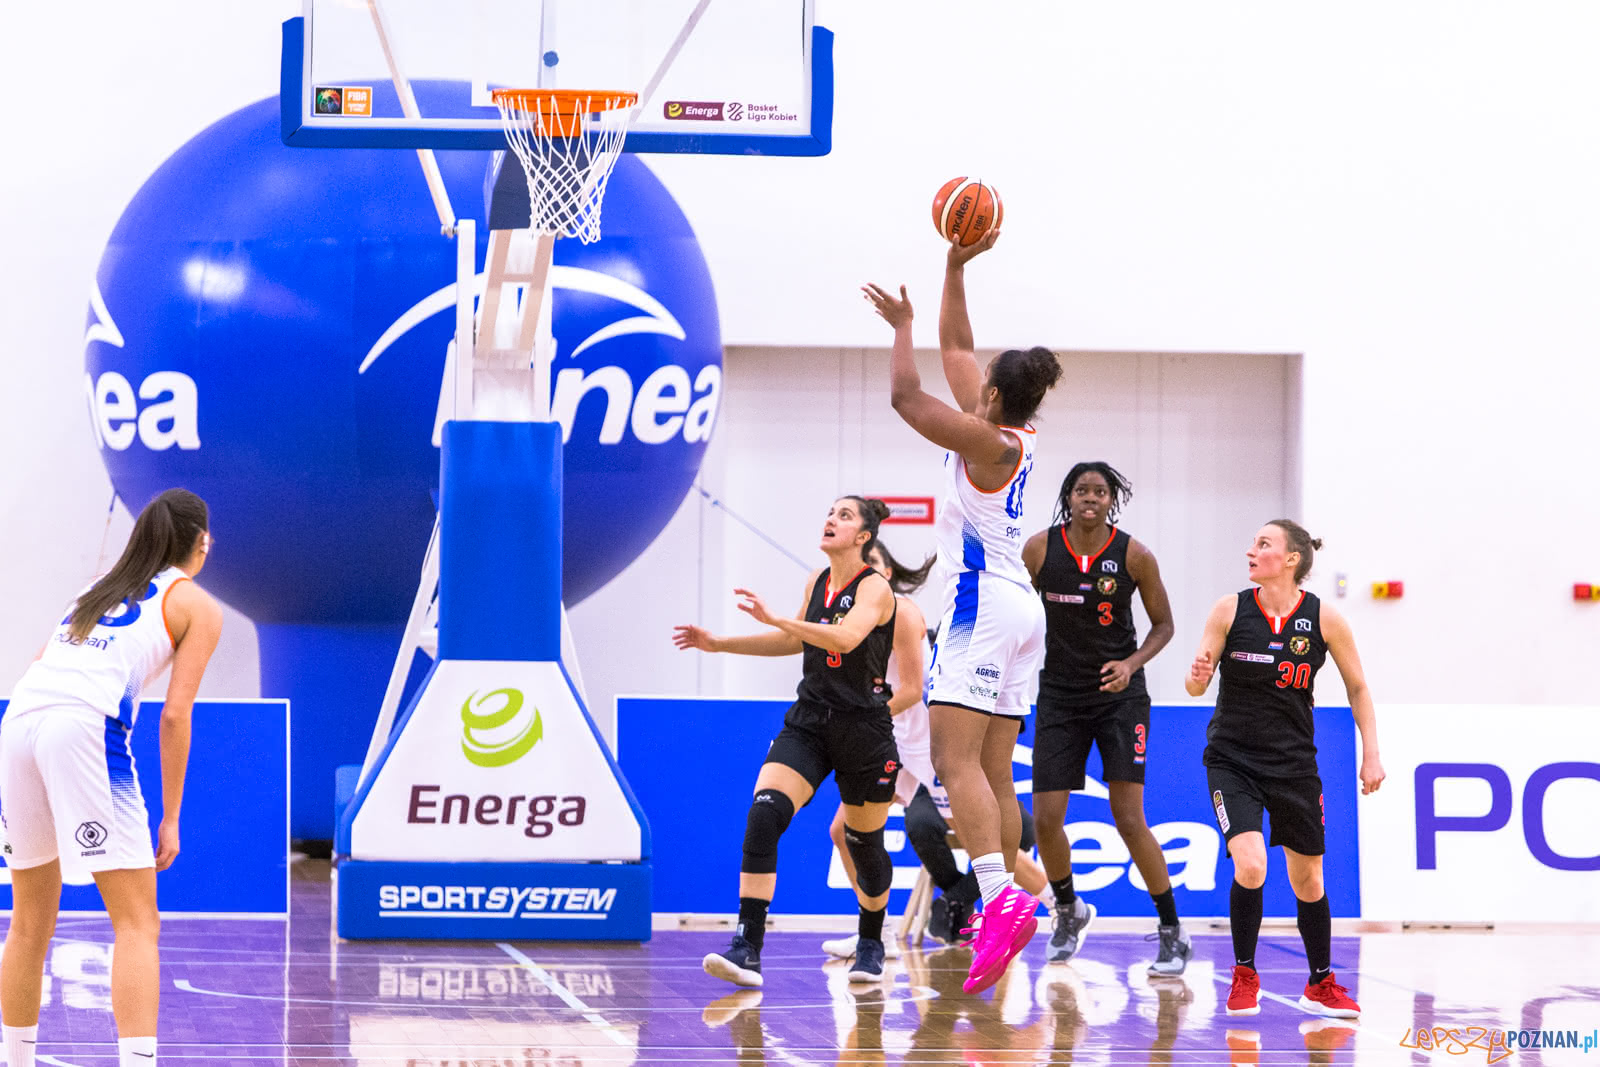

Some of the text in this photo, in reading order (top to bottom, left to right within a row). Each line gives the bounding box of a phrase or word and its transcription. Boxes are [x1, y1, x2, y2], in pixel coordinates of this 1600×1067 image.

[685, 106, 719, 117] Energa
[747, 104, 778, 112] Basket
[747, 113, 798, 122] Liga Kobiet
[1097, 602, 1114, 626] 3
[1275, 660, 1312, 689] 30
[1134, 723, 1146, 755] 3
[407, 784, 587, 838] Energa
[379, 885, 618, 916] SPORTSYSTEM
